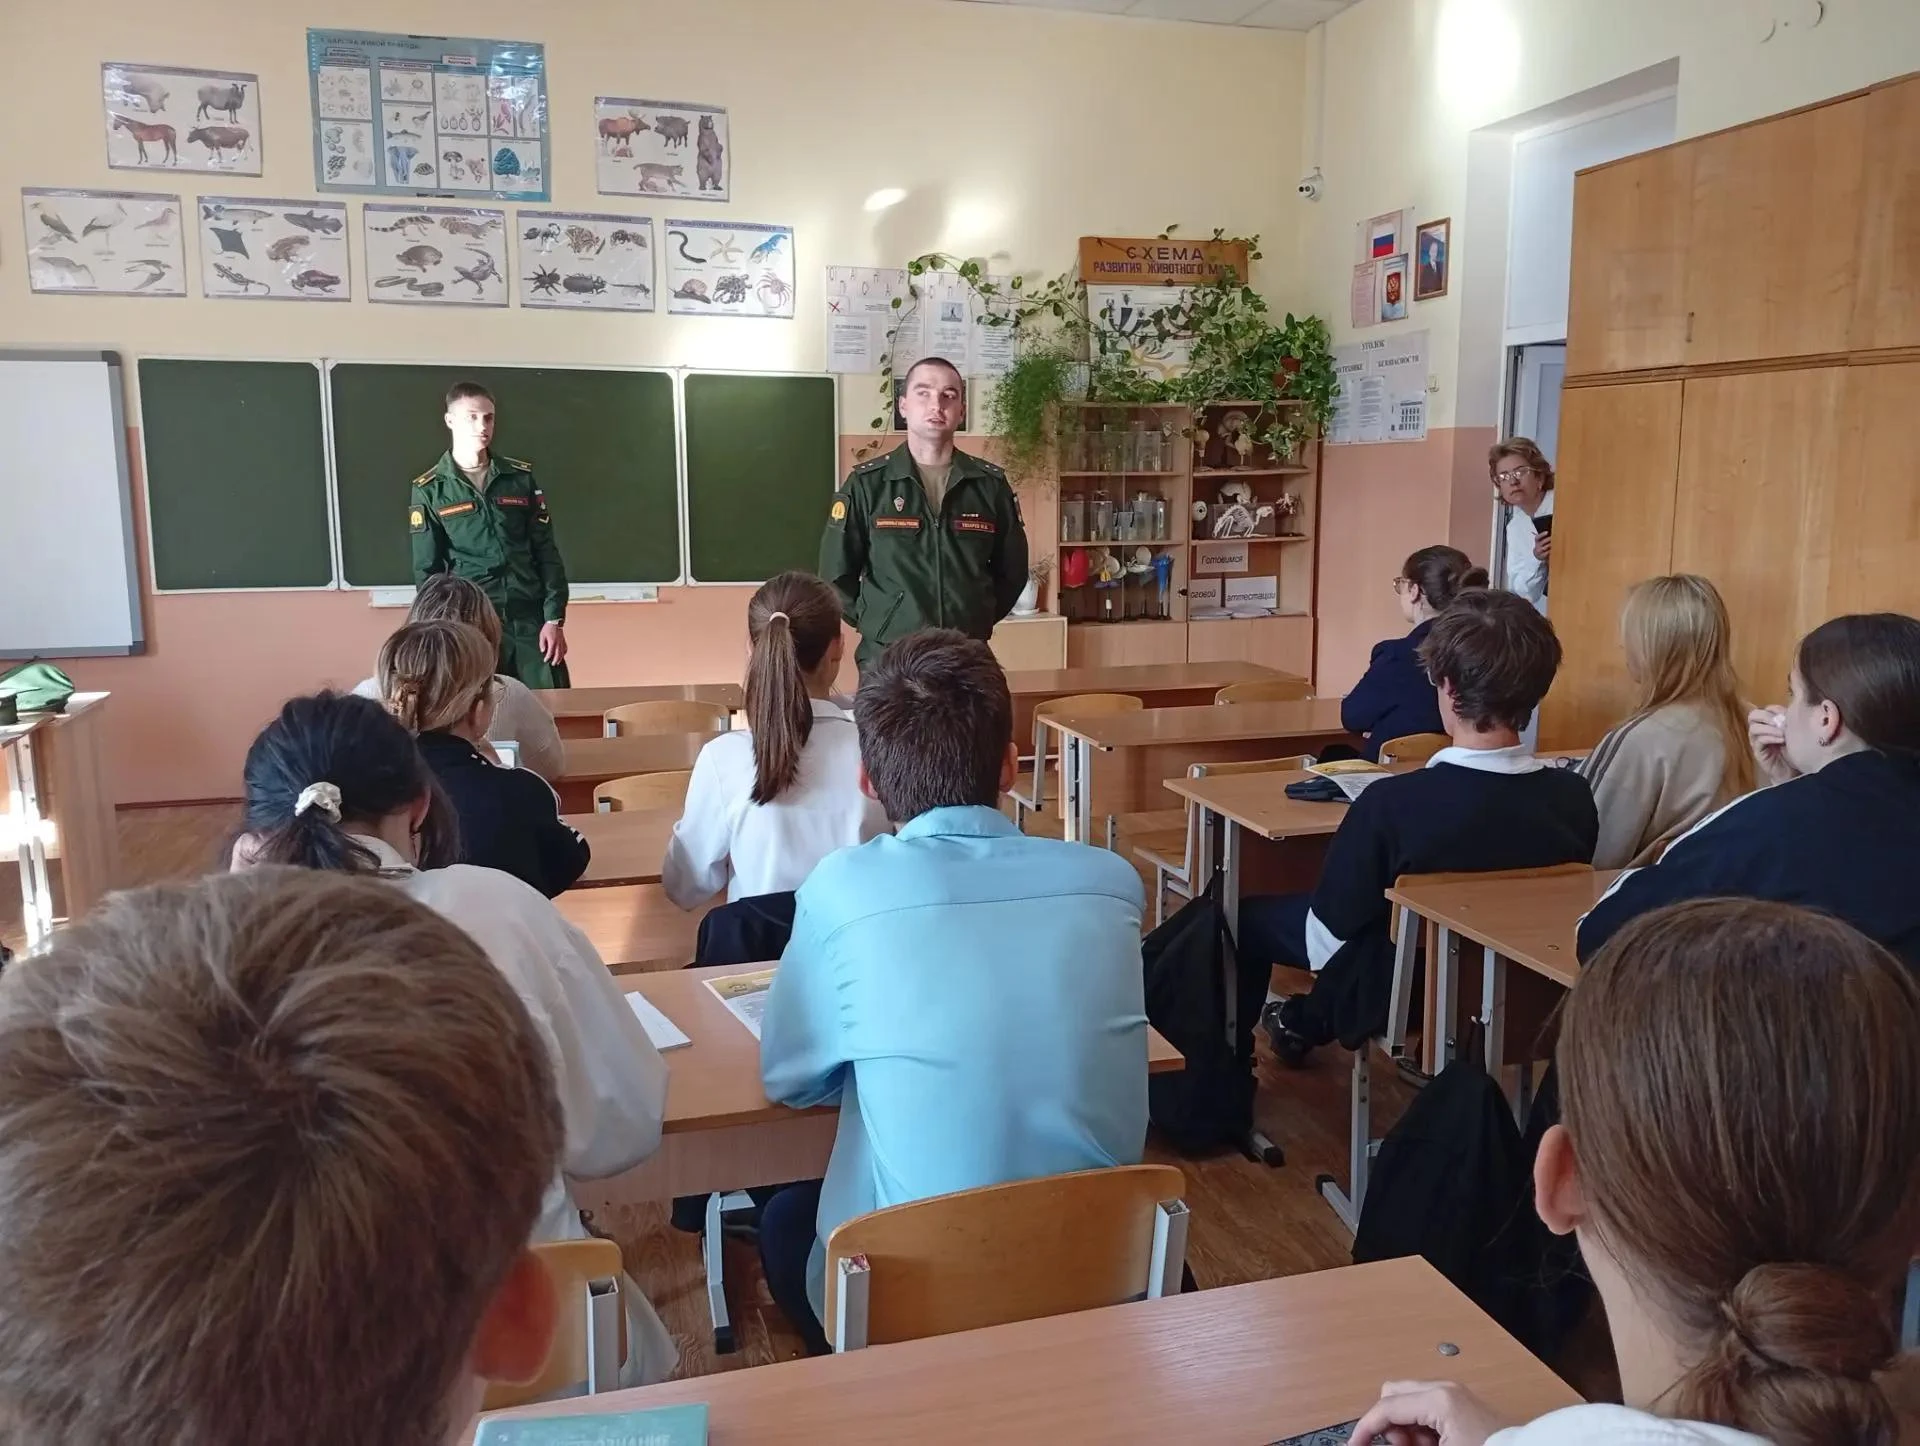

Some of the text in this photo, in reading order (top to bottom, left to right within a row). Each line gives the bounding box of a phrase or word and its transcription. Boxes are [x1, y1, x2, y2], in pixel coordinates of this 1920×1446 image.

[1126, 246, 1204, 261] СХЕМА
[1093, 261, 1142, 274] РАЗВИТИЯ
[1147, 262, 1204, 275] ЖИВОТНОГО
[1201, 555, 1243, 565] Готовимся
